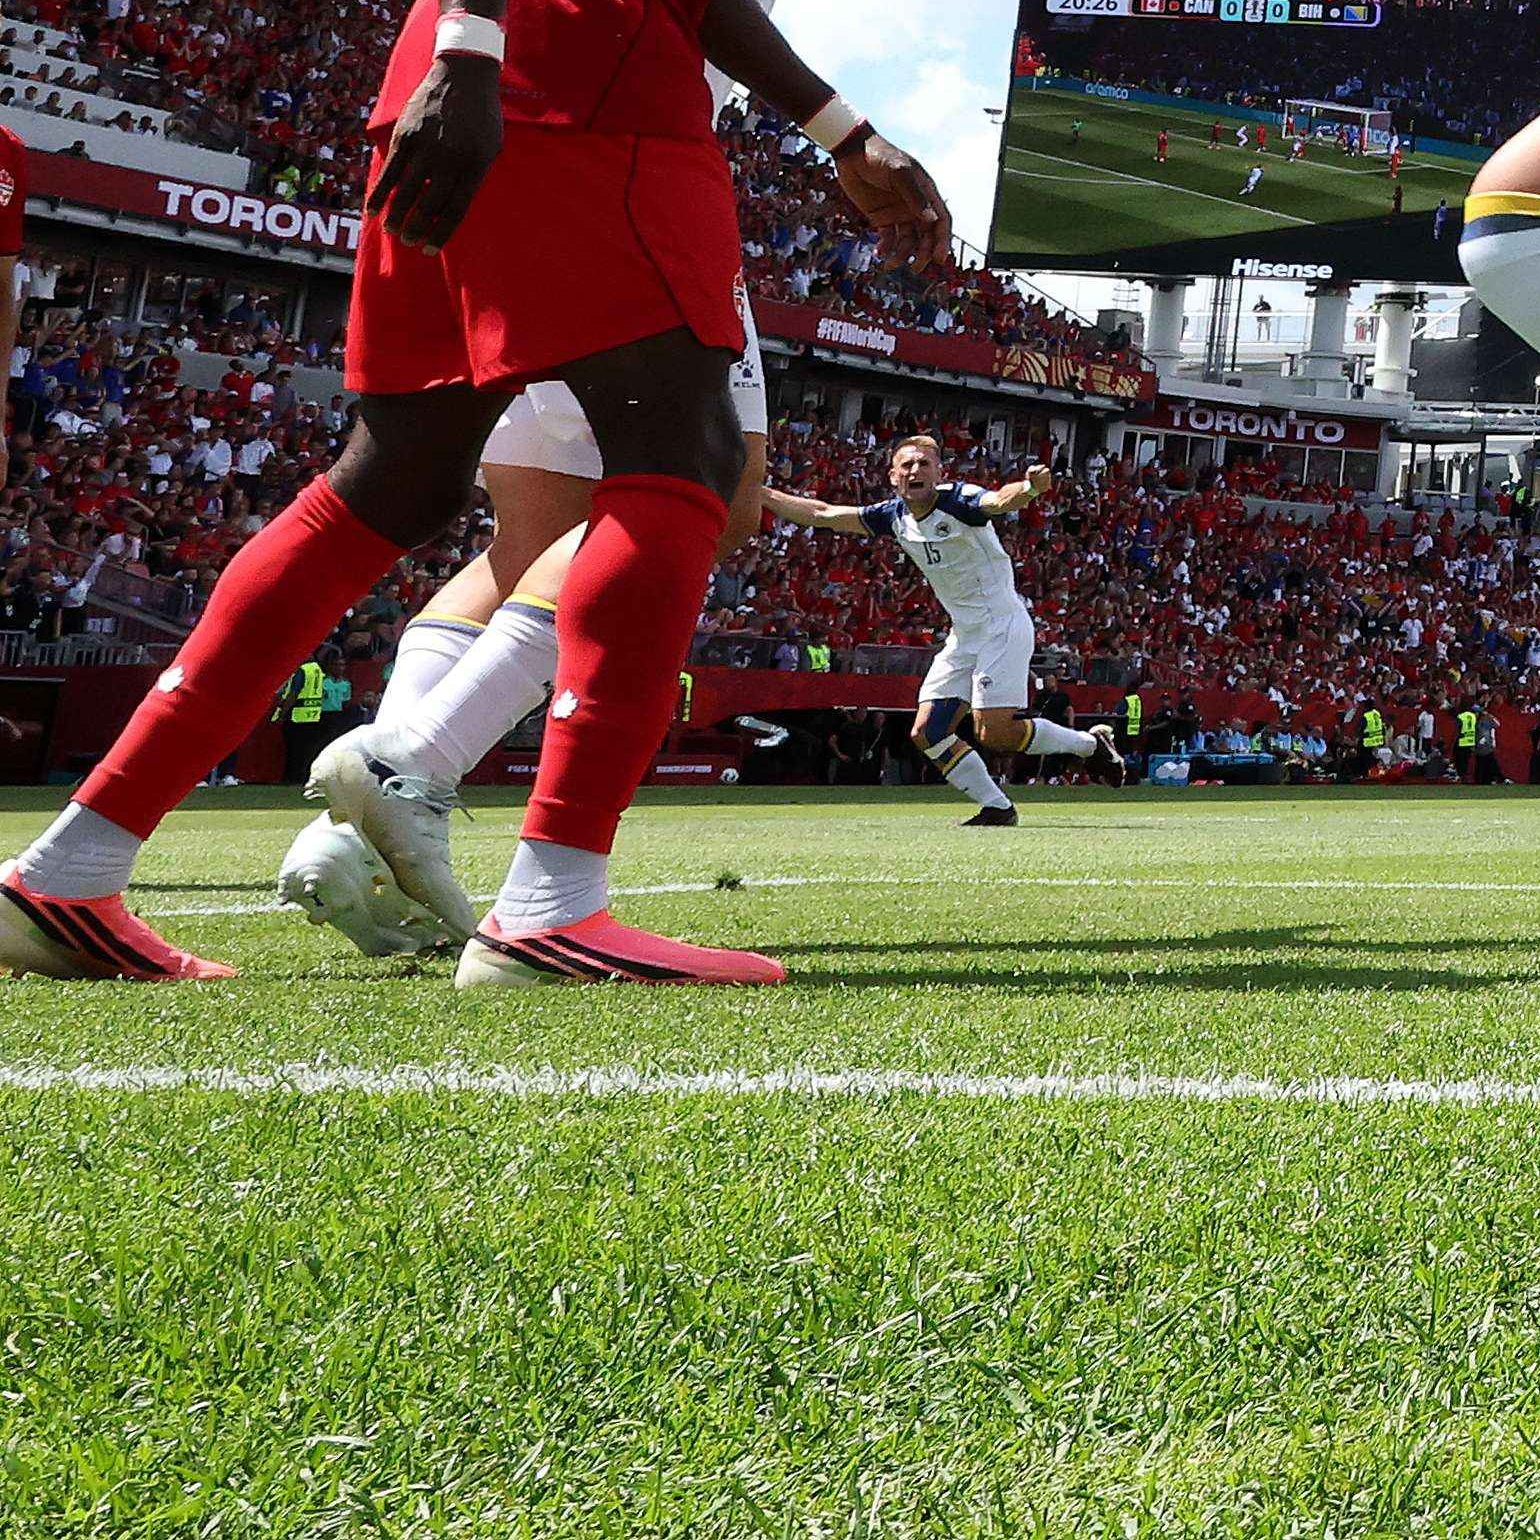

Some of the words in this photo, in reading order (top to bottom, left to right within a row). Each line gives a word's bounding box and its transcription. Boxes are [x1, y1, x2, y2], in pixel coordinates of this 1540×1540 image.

[157, 180, 363, 250] TORONT
[1231, 258, 1333, 279] Hisense
[1168, 402, 1345, 444] TORONTO
[922, 541, 941, 565] 15
